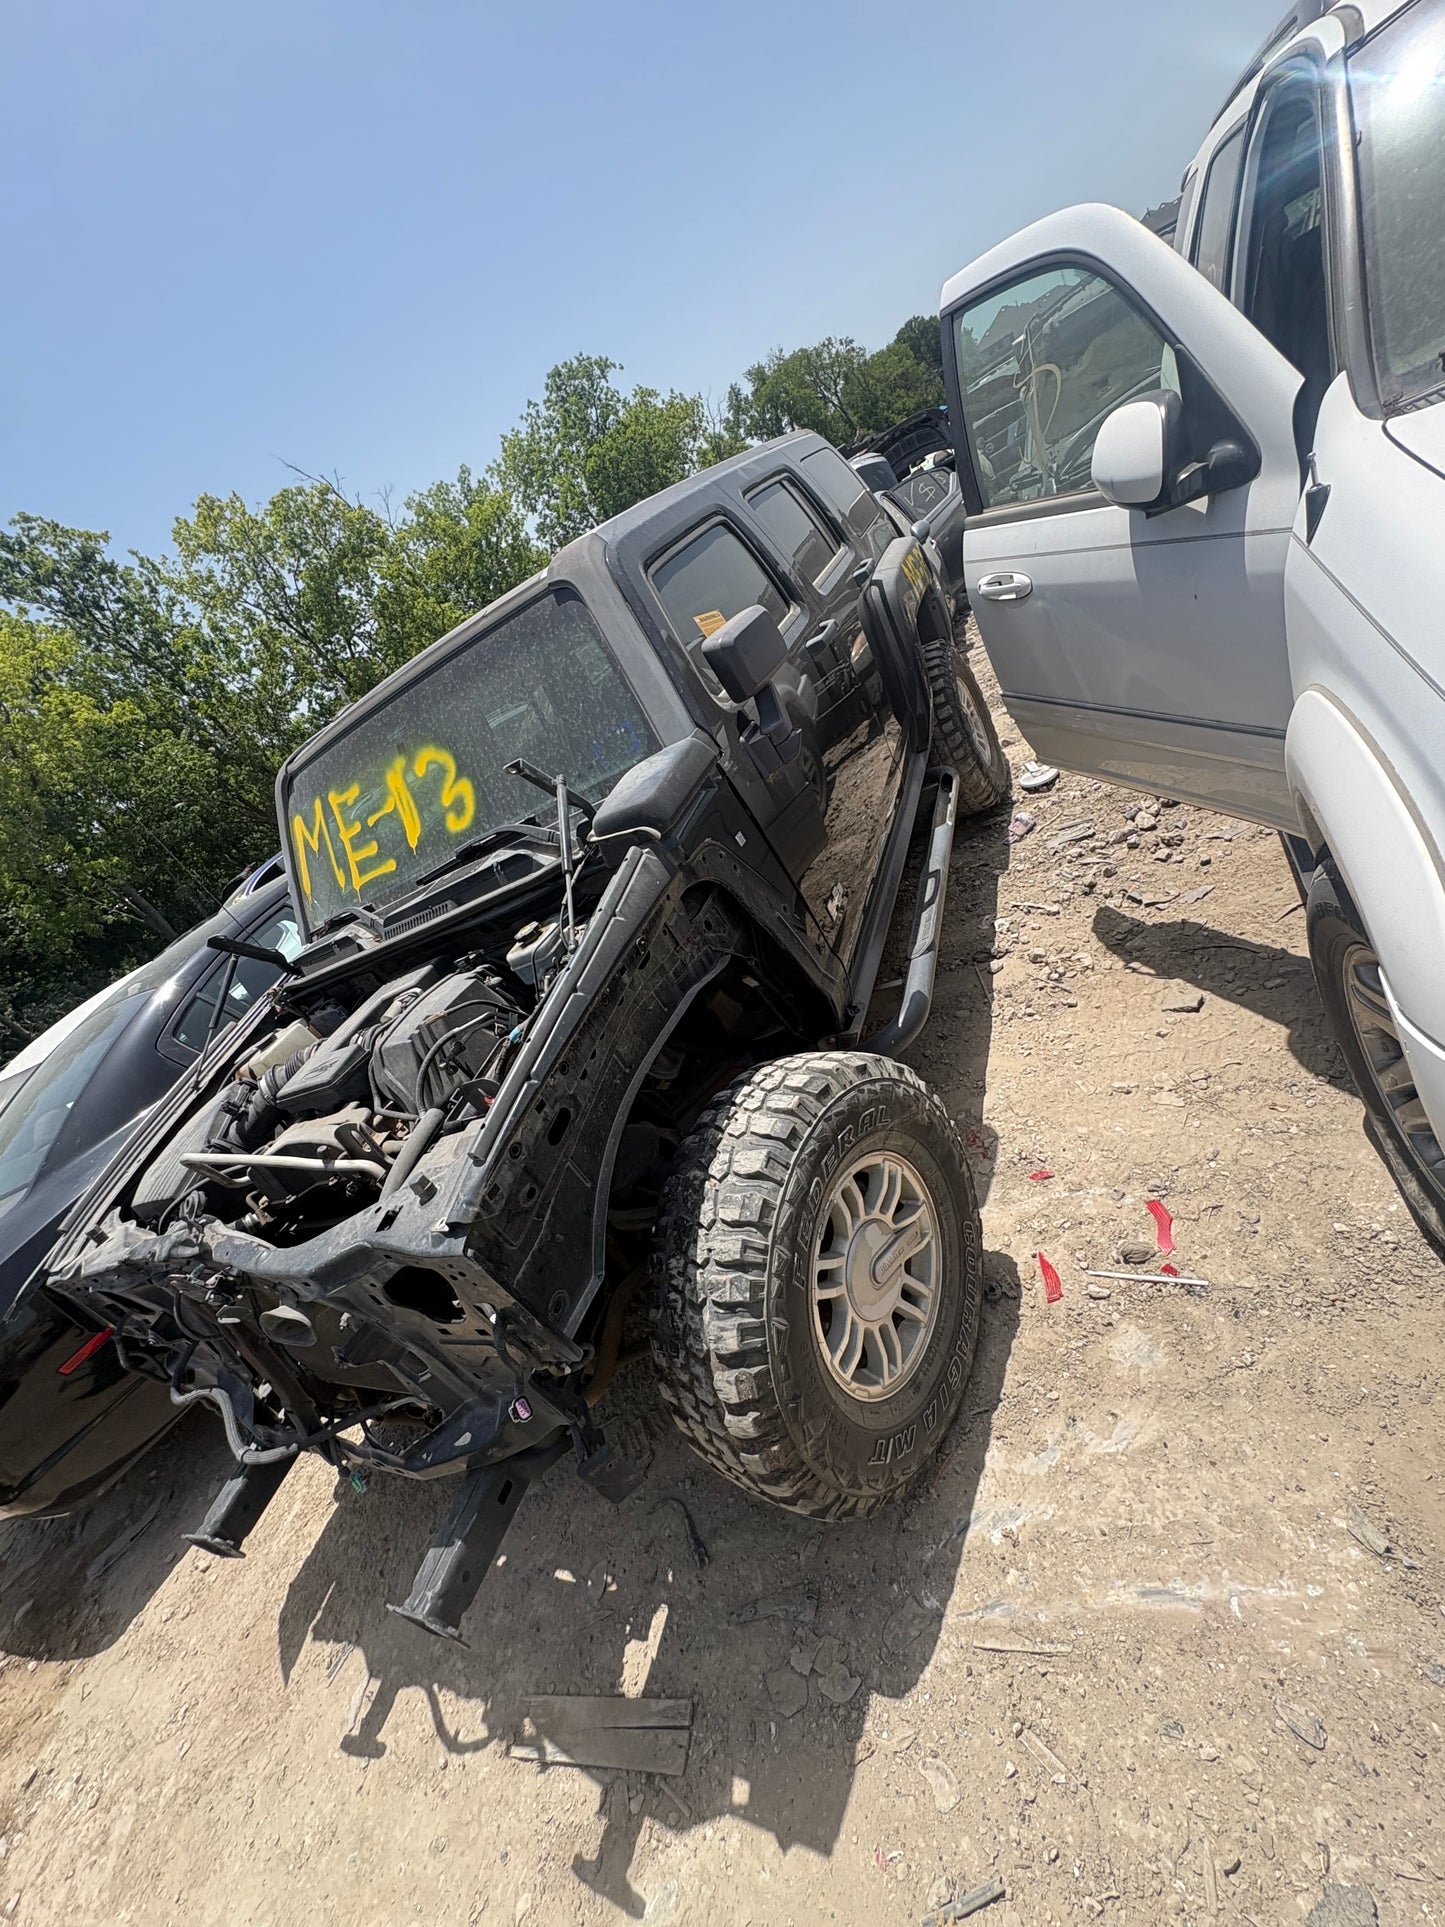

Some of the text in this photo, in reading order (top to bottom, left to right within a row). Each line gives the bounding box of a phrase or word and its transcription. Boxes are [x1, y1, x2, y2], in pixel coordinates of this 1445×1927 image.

[792, 1105, 891, 1291] FEDERAL
[923, 1221, 976, 1433] COURAGIA
[868, 1424, 917, 1466] M/T
